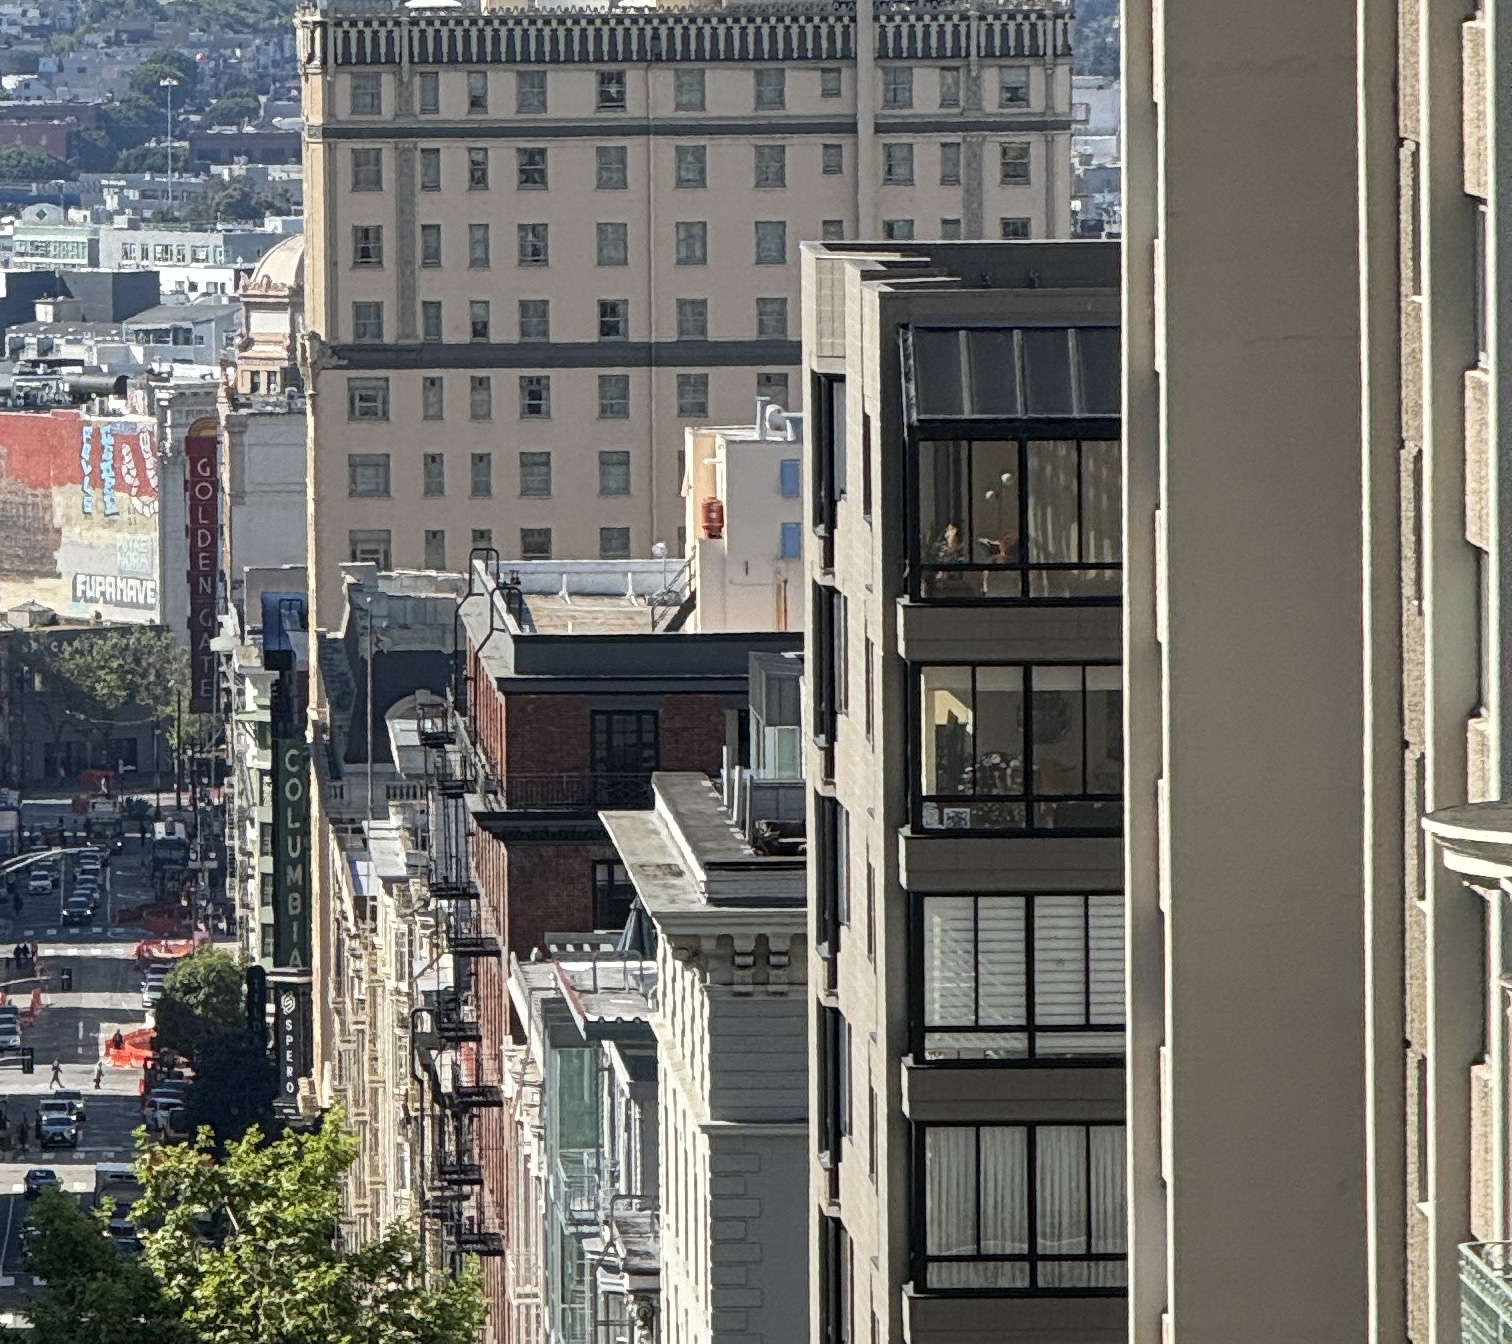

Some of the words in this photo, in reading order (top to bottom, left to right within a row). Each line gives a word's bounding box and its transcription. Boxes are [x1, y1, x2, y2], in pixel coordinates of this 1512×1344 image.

[195, 458, 214, 595] GOLDEN
[198, 608, 214, 698] GATE
[284, 748, 304, 968] COLUMBIA
[285, 1018, 295, 1094] SPERO
